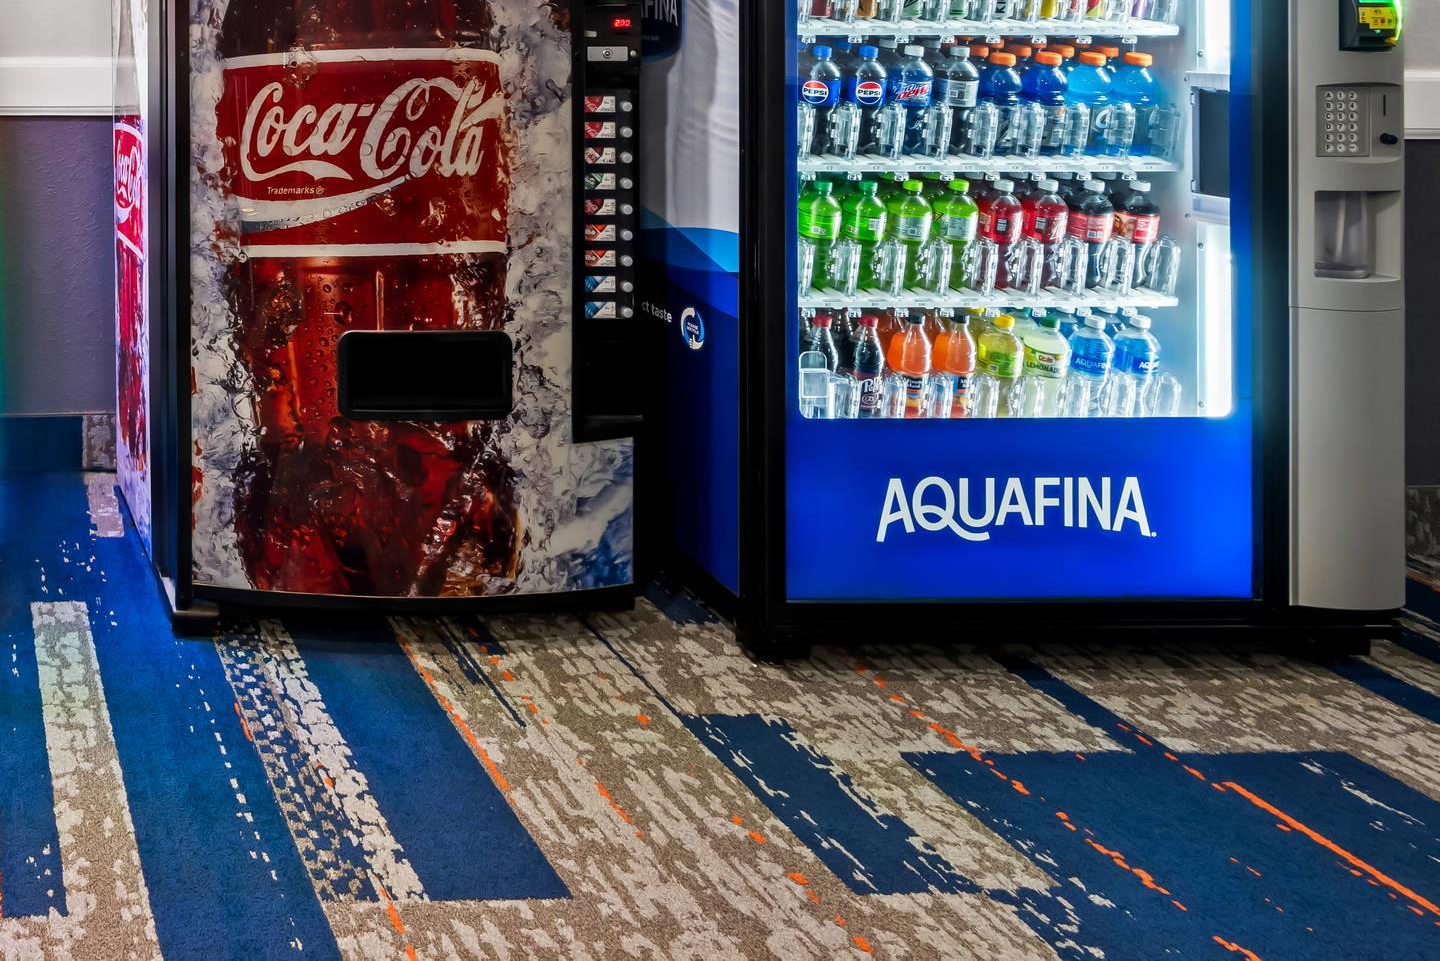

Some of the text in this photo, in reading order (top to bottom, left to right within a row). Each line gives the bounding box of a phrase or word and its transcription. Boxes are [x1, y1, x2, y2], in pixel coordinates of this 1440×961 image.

[803, 87, 828, 96] PEPSI
[857, 88, 881, 96] PEPSI
[241, 77, 505, 180] Coca-Cola
[651, 303, 672, 323] taste
[875, 476, 1152, 543] AQUAFINA
